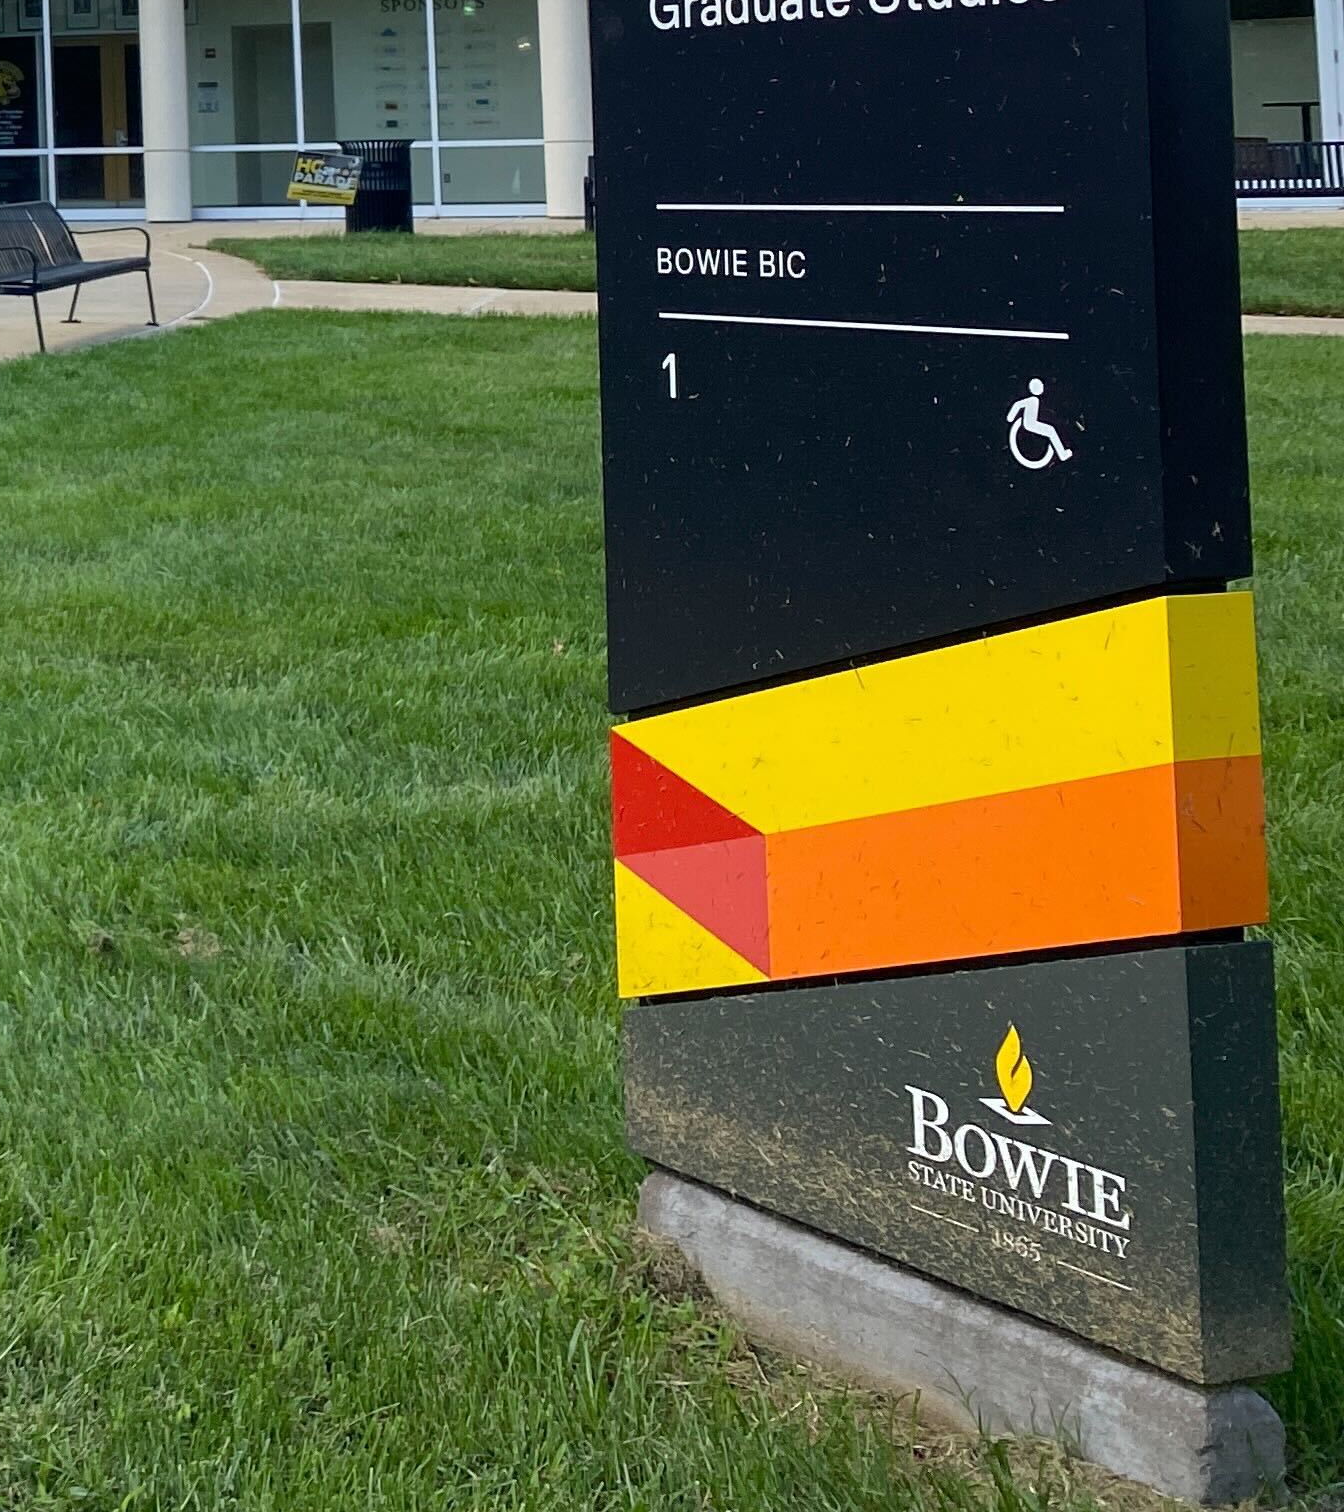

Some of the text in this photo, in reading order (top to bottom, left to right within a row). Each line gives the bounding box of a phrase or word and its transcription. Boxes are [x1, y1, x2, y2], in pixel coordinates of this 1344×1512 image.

[294, 171, 358, 190] PARADE
[656, 247, 806, 279] BOWIE BIC
[662, 352, 677, 399] 1
[904, 1085, 1131, 1230] BOWIE
[908, 1160, 1131, 1259] STATE UNIVERSITY
[992, 1228, 1042, 1262] 1865
